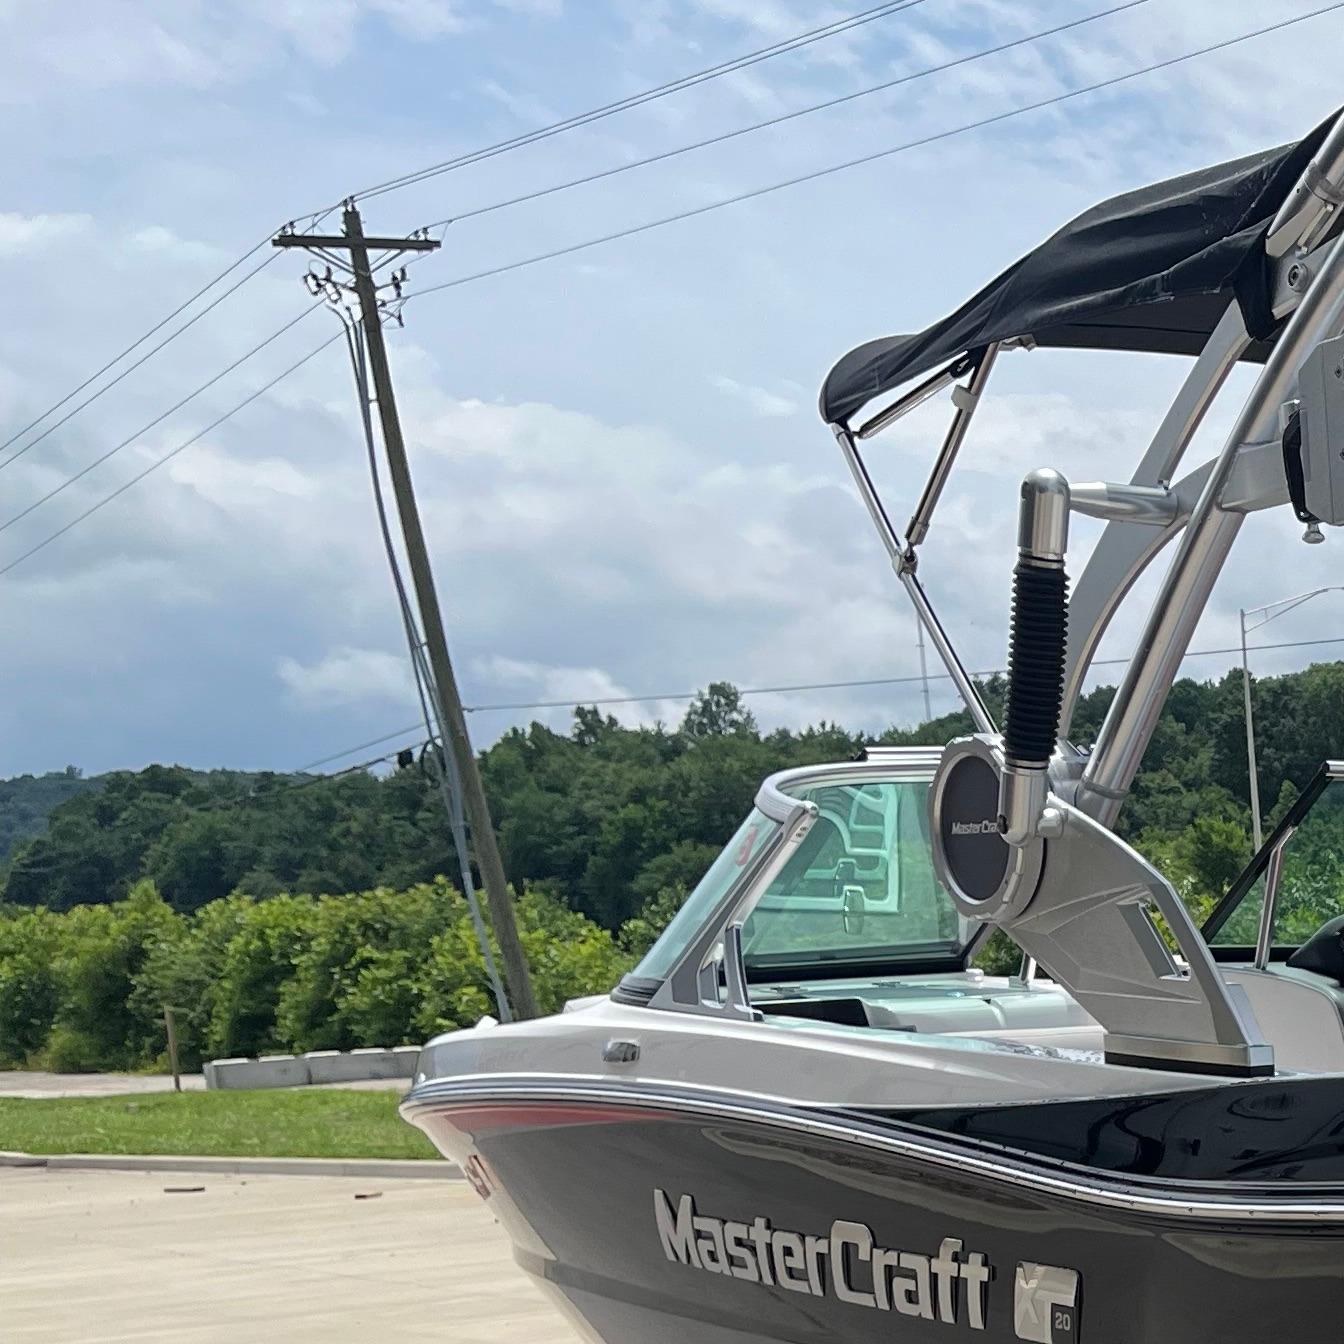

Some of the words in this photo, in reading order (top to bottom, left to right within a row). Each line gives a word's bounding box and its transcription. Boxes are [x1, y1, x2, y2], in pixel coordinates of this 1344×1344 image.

[952, 820, 998, 835] MasterCra
[653, 1188, 993, 1330] MasterCraft
[1054, 1311, 1071, 1332] 20
